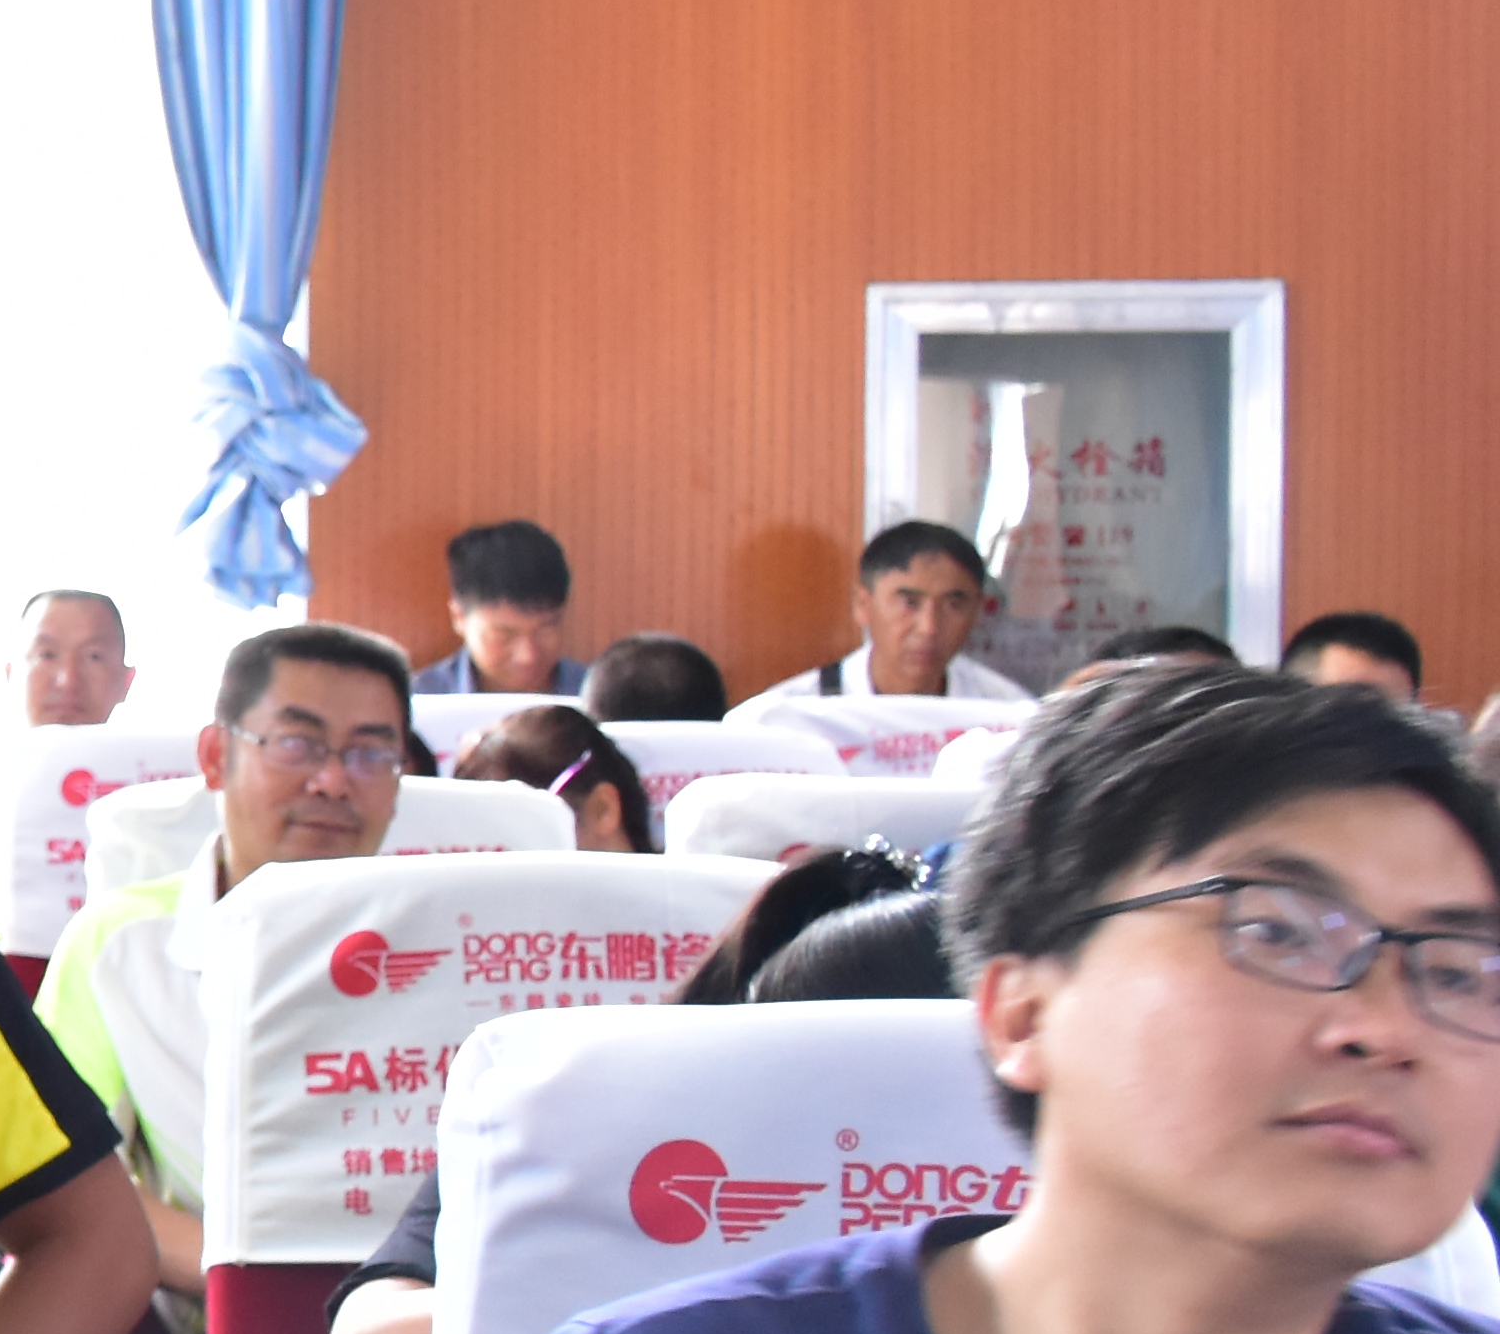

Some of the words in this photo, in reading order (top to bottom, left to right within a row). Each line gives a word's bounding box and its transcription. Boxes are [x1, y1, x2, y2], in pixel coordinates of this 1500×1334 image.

[463, 932, 556, 958] DONG
[463, 958, 551, 984] PENG
[342, 1105, 440, 1126] FIVE
[841, 1162, 989, 1204] DONG
[345, 1187, 373, 1215] 电
